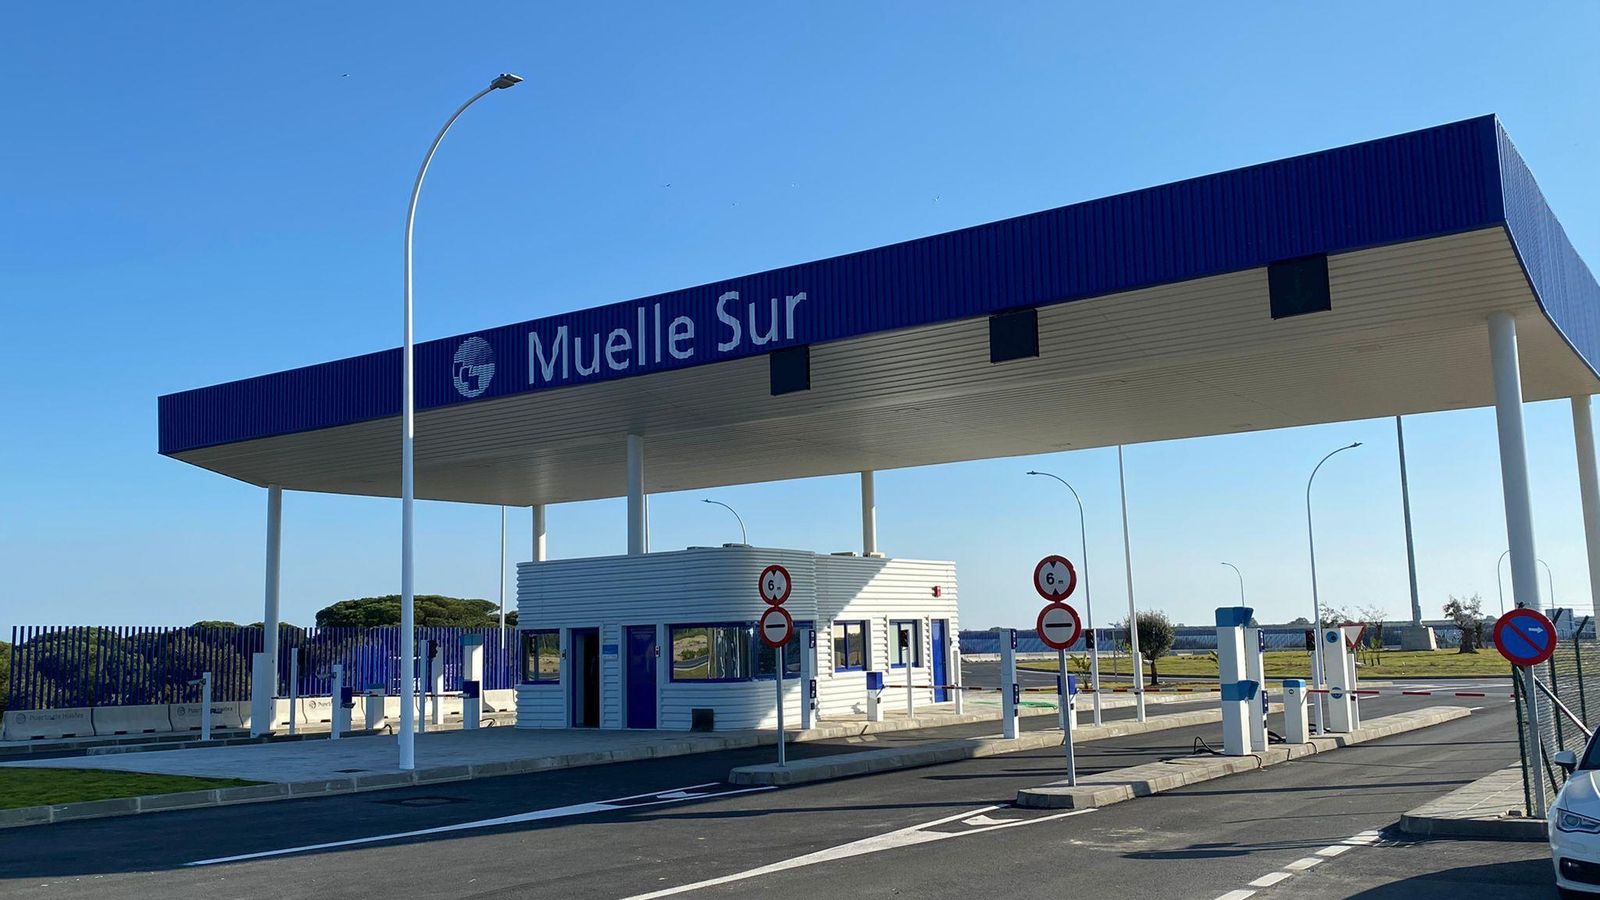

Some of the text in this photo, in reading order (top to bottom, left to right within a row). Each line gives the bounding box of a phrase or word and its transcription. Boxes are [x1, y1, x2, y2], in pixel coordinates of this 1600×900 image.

[528, 290, 807, 384] Muelle Sur
[1046, 572, 1055, 585] 6
[768, 580, 775, 591] 6
